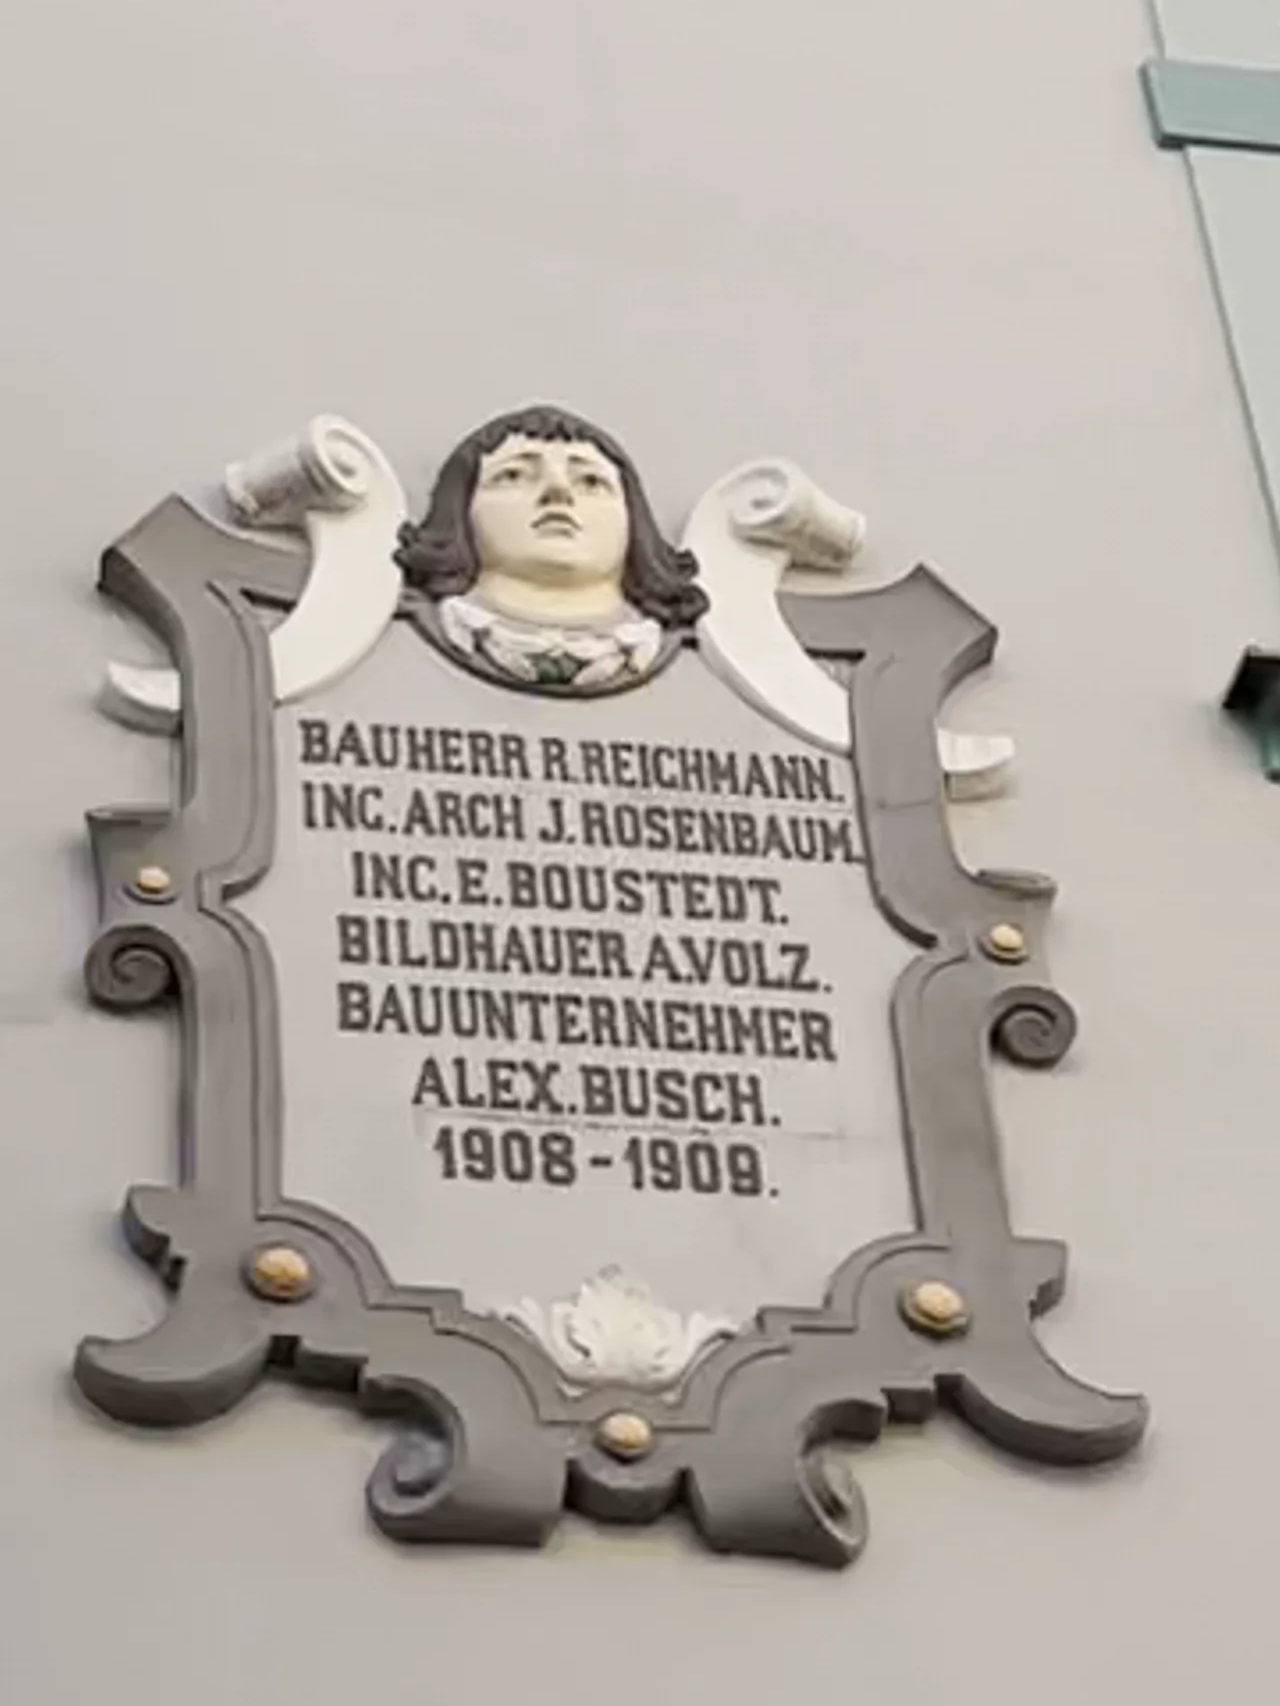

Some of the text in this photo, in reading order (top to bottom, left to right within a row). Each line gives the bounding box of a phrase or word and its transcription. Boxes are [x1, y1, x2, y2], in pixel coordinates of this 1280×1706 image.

[298, 718, 531, 781] BAUHERR
[336, 913, 634, 980] BILDHAUER
[336, 981, 837, 1063] BAUUNTERNEHMER
